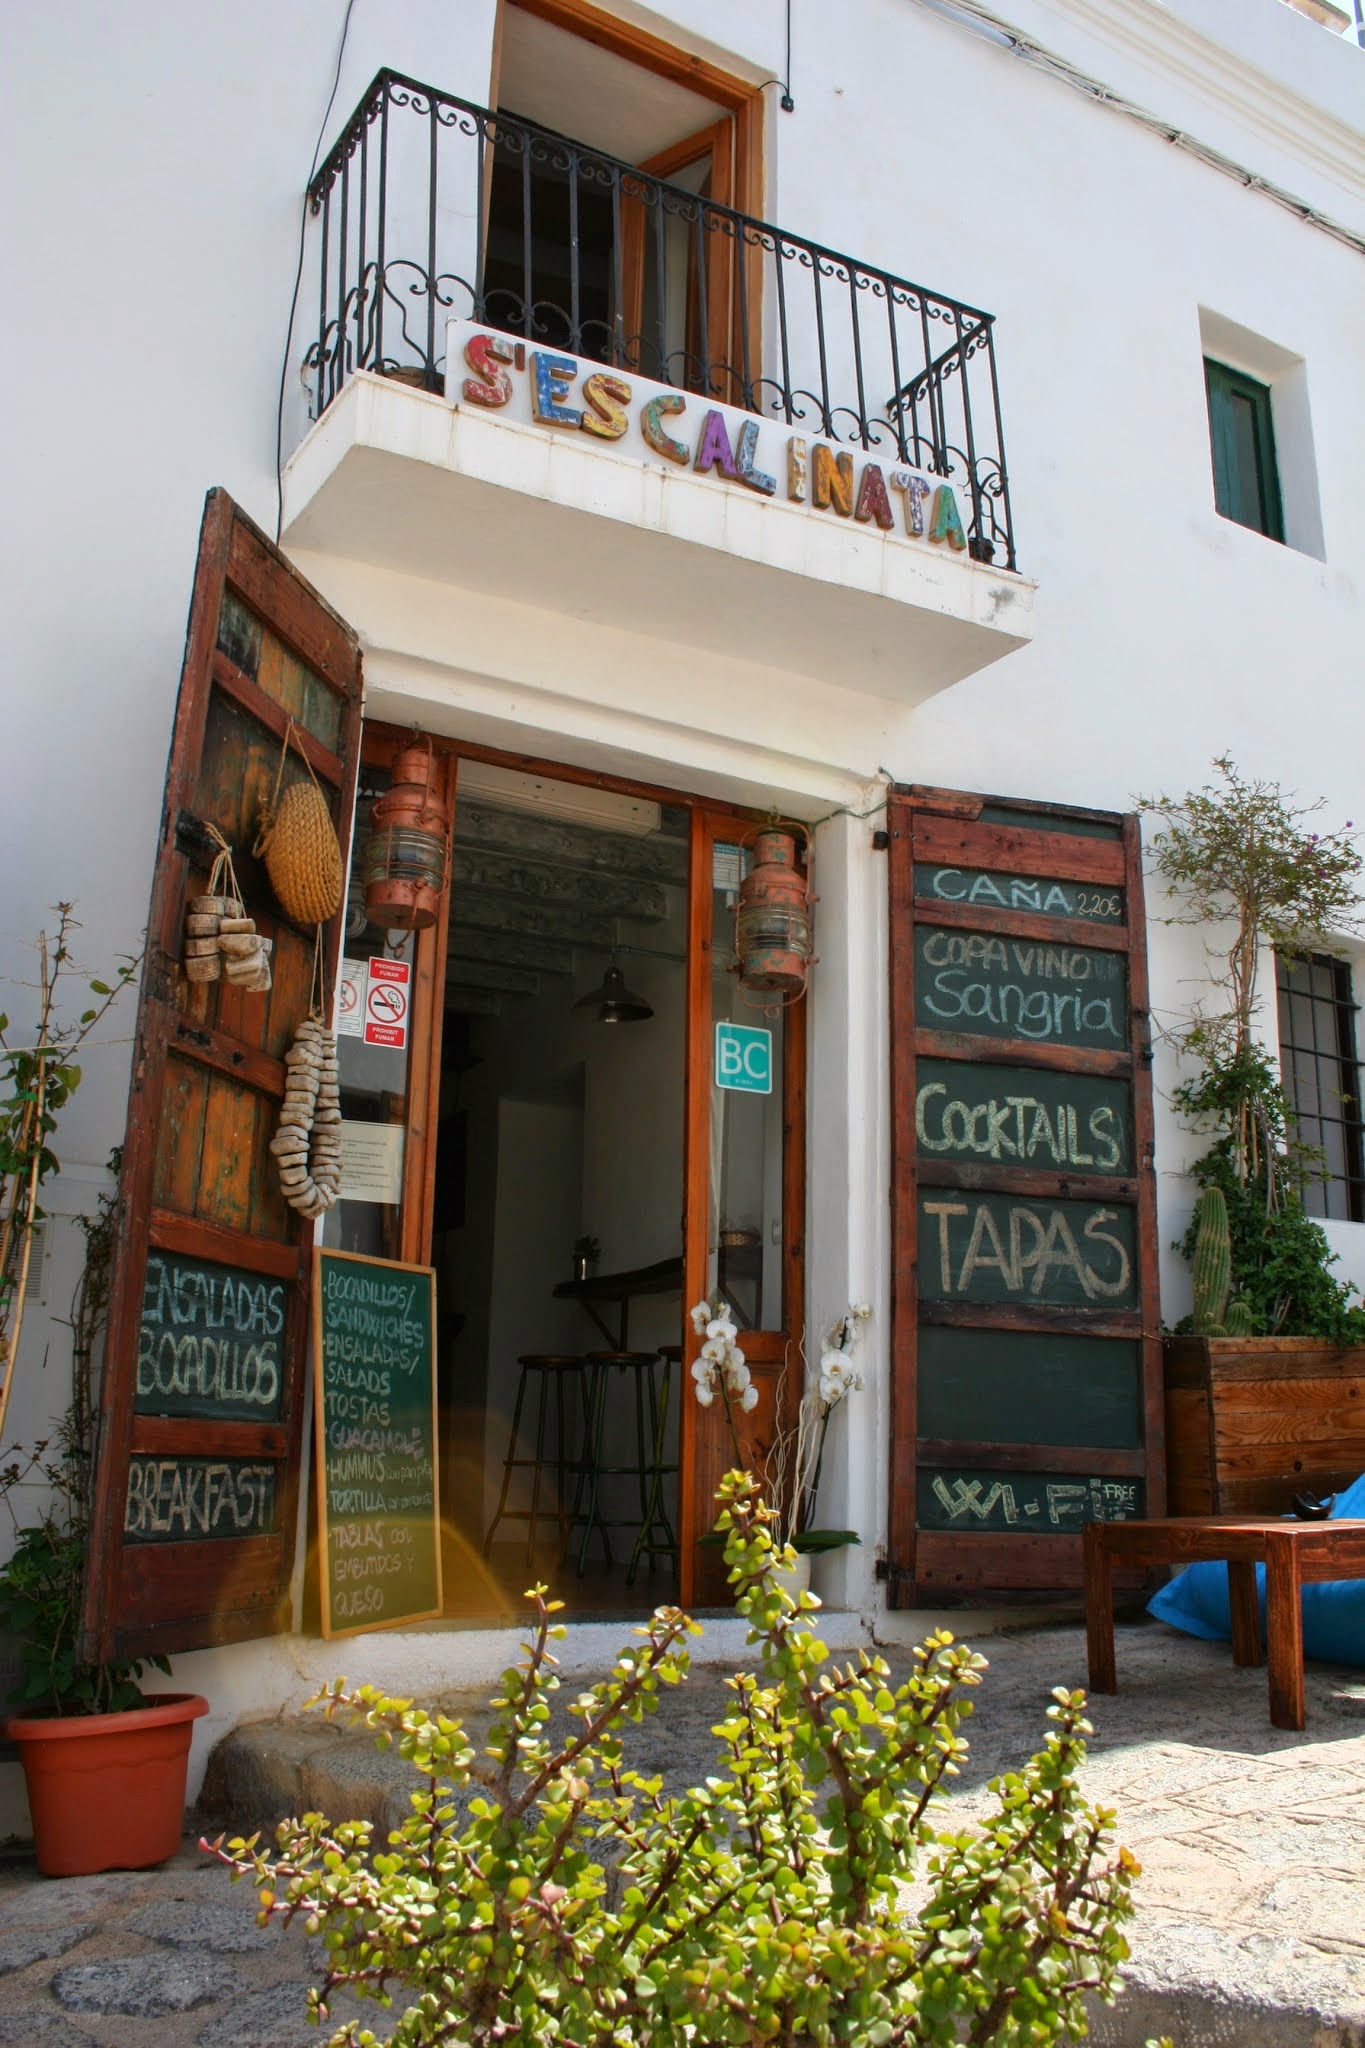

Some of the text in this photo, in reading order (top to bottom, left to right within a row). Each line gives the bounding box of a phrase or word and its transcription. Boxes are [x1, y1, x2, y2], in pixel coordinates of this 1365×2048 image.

[464, 332, 968, 552] S'ESCALINATA
[933, 869, 1073, 914] CAÑA
[374, 963, 405, 973] PROHIBIDO
[924, 932, 1091, 980] COPA VINO
[379, 970, 399, 978] FUMAR
[924, 969, 1121, 1038] Sangria
[372, 1026, 398, 1036] PROHIBIT
[374, 1034, 395, 1042] FUMAR
[720, 1037, 767, 1078] BC
[923, 1201, 1131, 1299] TAPAS
[142, 1258, 284, 1335] ENSALADAS
[326, 1302, 424, 1348] SANDWICHES
[136, 1326, 279, 1405] BOCADILLOS
[326, 1361, 391, 1396] SALADS
[326, 1391, 391, 1426] TOSTAS
[329, 1421, 424, 1459] GUACAMOLE
[330, 1453, 386, 1482] HUMMUS
[124, 1461, 275, 1534] BREAKFAST
[329, 1490, 387, 1513] TORTILLA
[1103, 1484, 1136, 1501] FREE
[332, 1520, 384, 1549] TABLAS
[334, 1554, 401, 1582] EMBUTIDOS
[334, 1585, 384, 1617] QUESO
